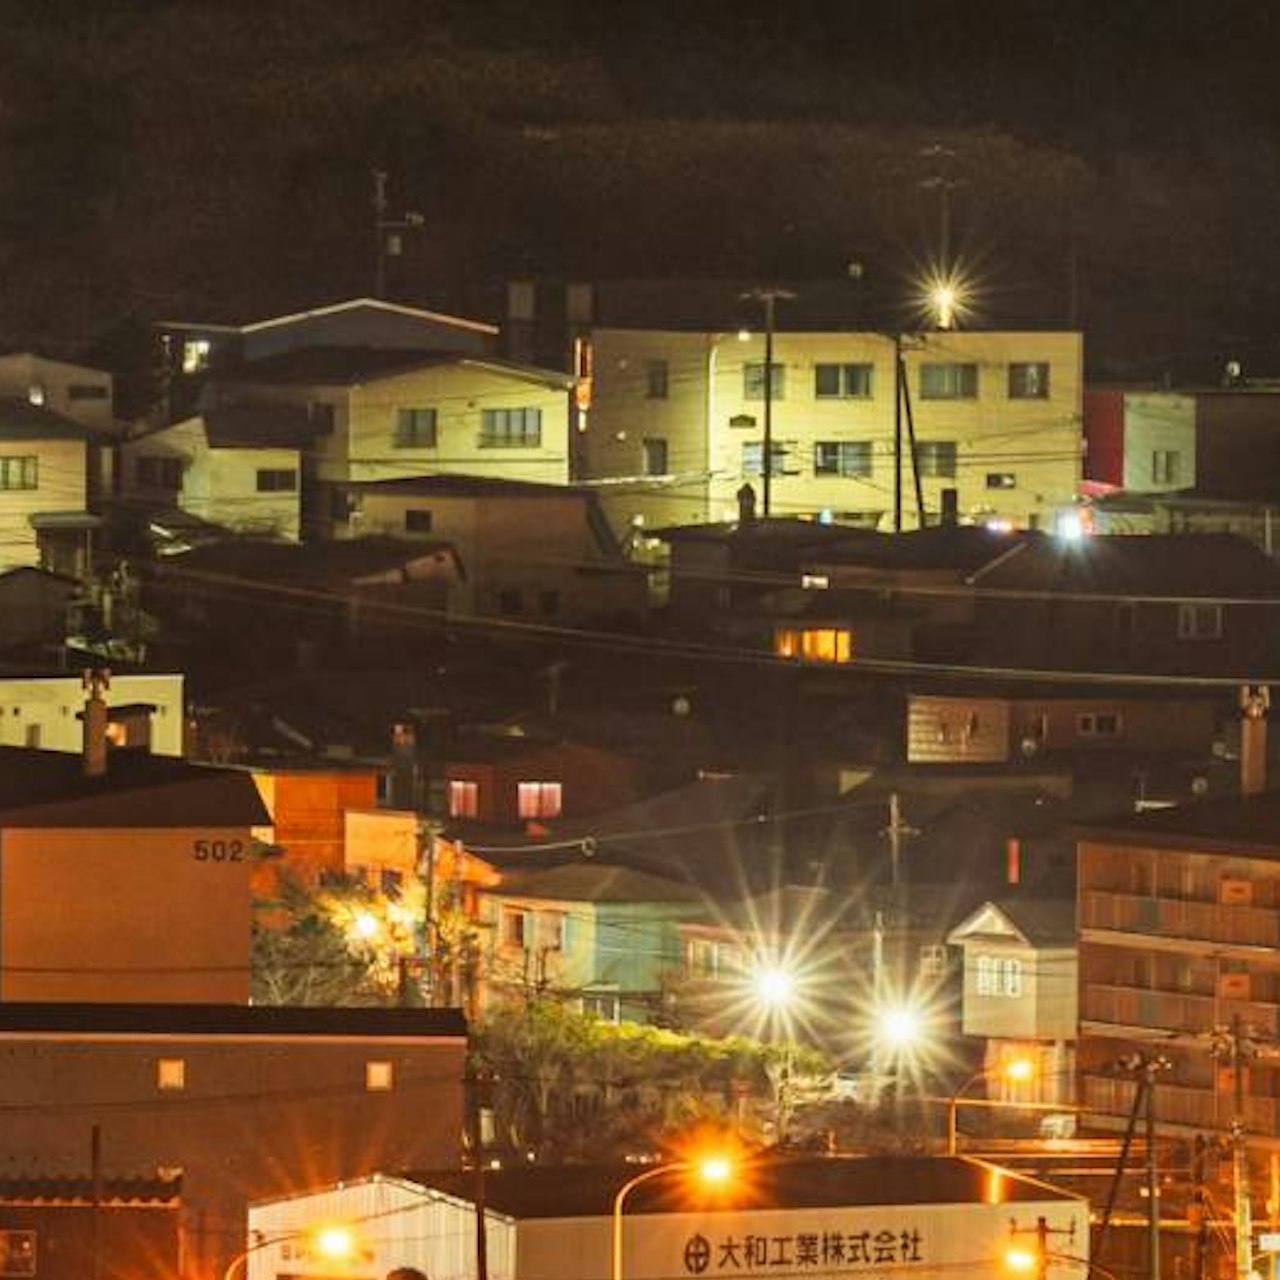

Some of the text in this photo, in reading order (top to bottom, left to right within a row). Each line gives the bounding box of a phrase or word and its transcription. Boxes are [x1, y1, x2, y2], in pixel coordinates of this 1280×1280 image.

[193, 839, 243, 862] 502
[717, 1227, 924, 1269] 大和工業株式会社
